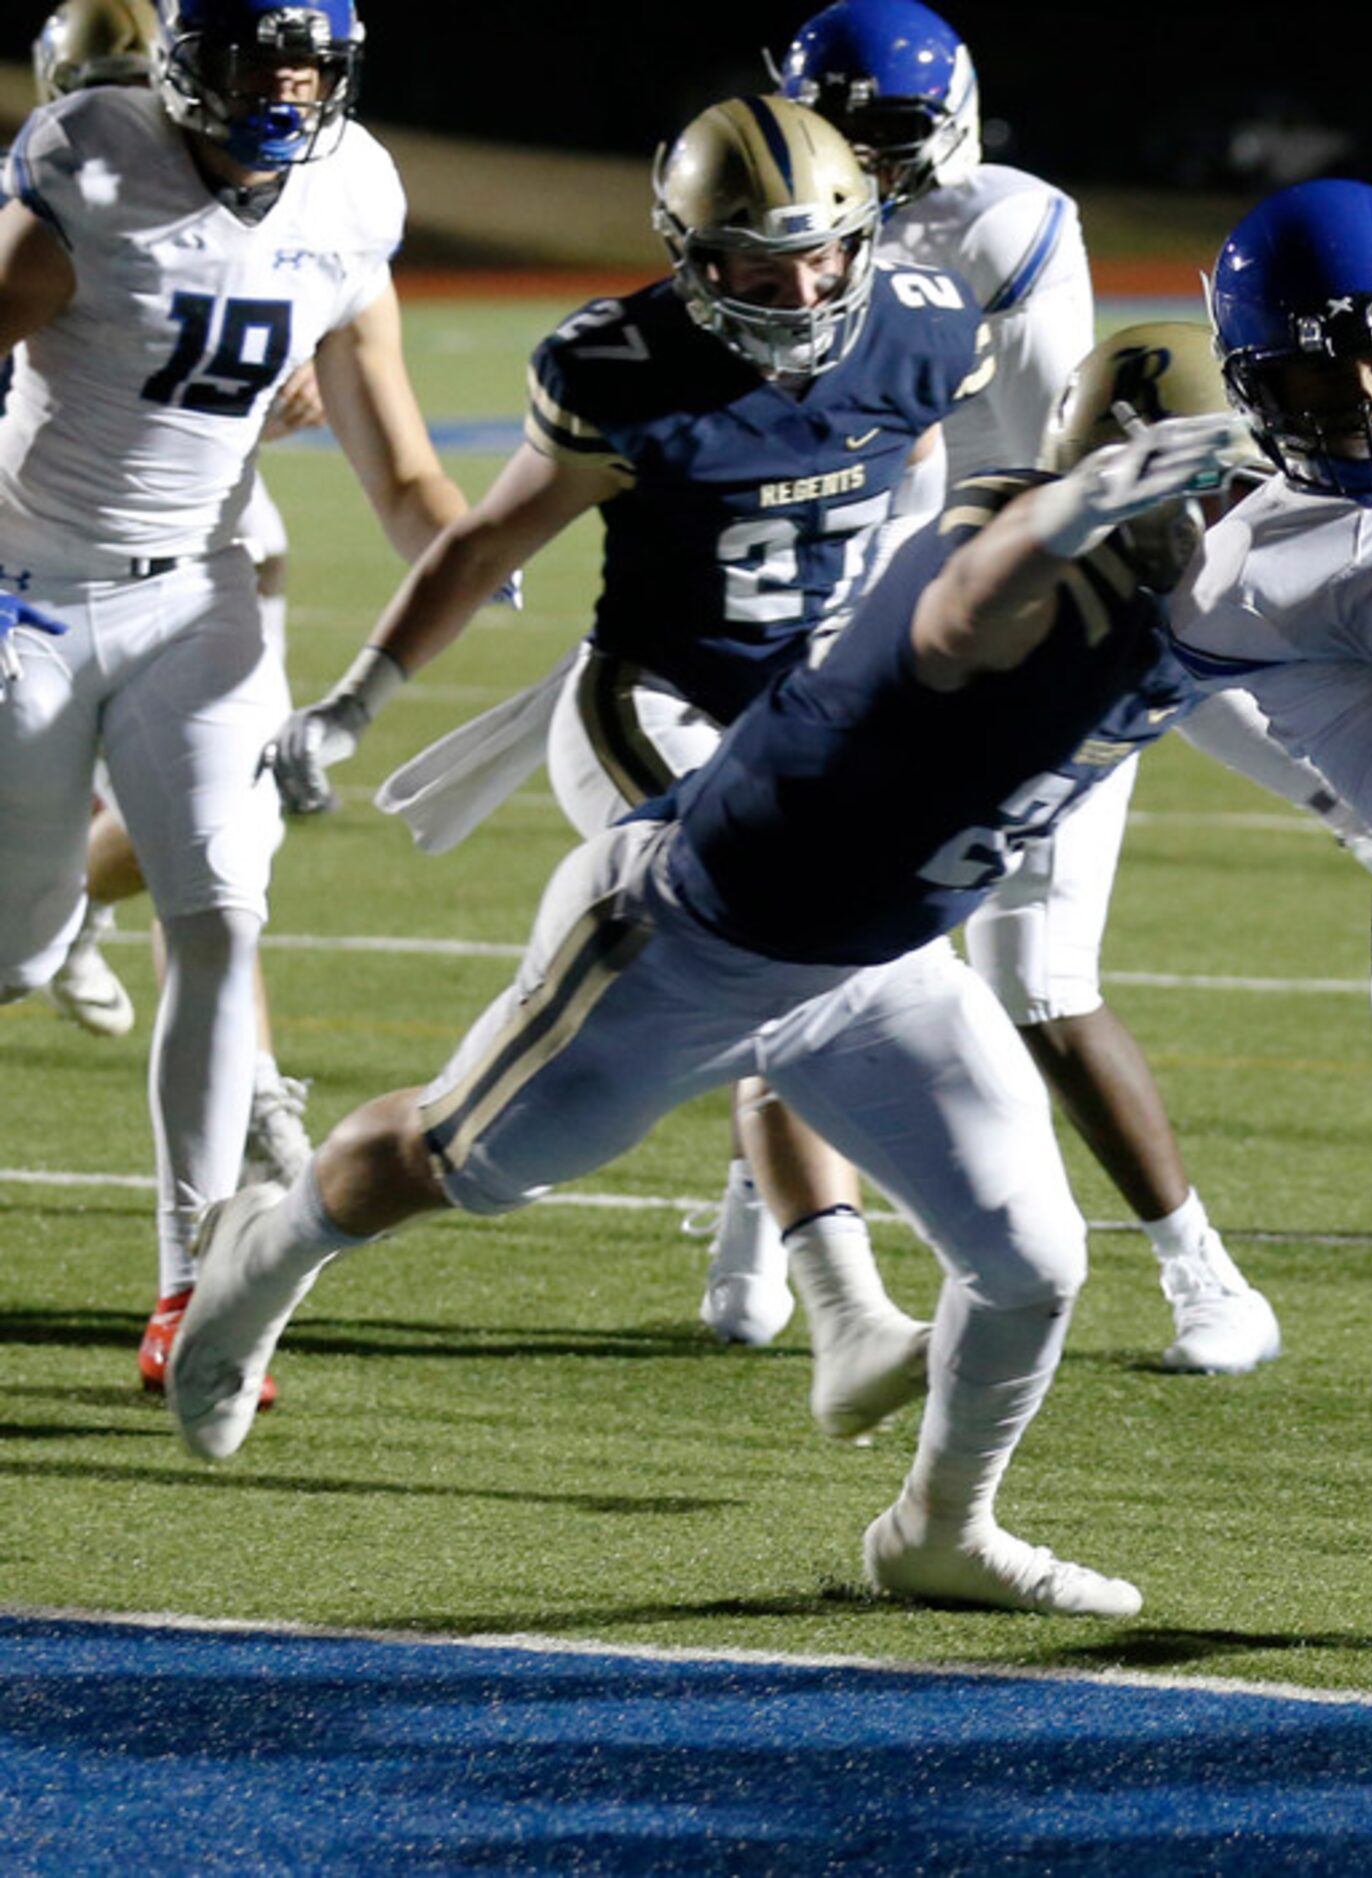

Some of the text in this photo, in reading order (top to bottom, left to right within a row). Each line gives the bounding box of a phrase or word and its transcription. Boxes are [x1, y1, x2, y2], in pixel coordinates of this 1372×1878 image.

[140, 290, 292, 418] 19
[556, 300, 650, 360] 27
[759, 463, 866, 507] REGENTS
[717, 490, 892, 623] 27
